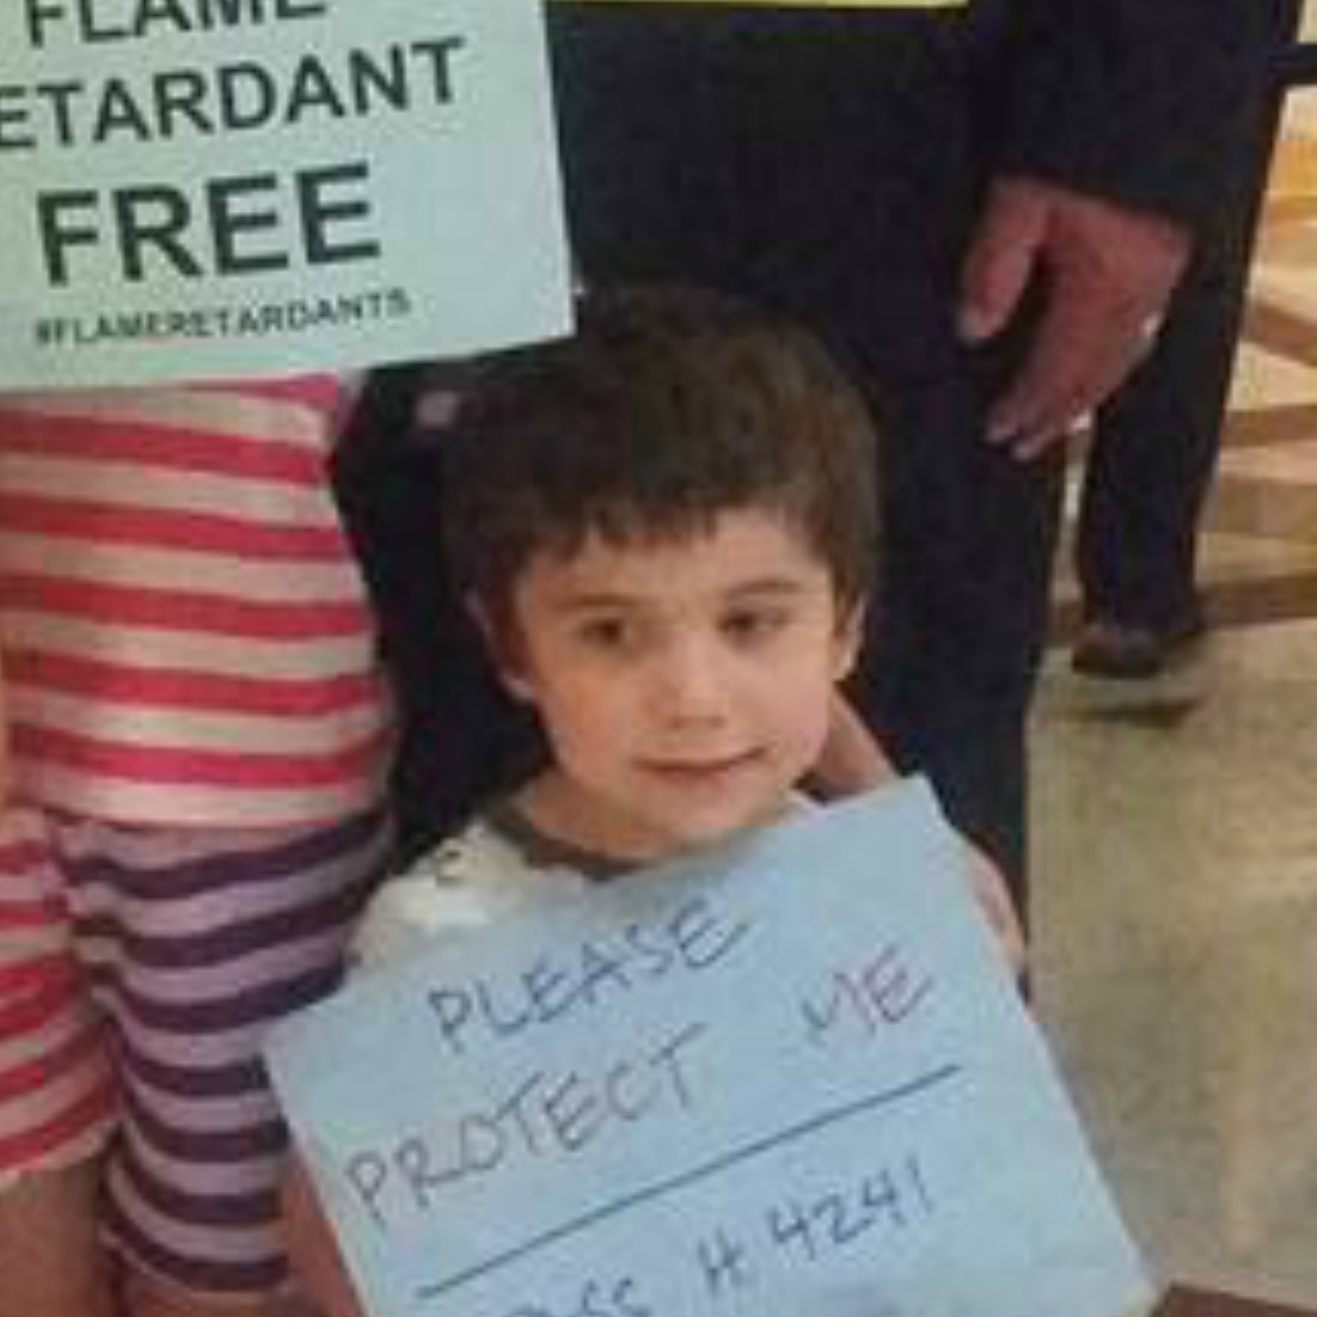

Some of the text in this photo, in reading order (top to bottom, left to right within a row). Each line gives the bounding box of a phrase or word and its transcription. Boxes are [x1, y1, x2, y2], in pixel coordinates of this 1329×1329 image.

[36, 161, 381, 286] FREE
[35, 287, 411, 347] #FLAMERETARDANTS
[428, 897, 749, 1055] PLEASE
[345, 946, 935, 1230] PROTECT ME
[765, 1153, 935, 1261] 4241
